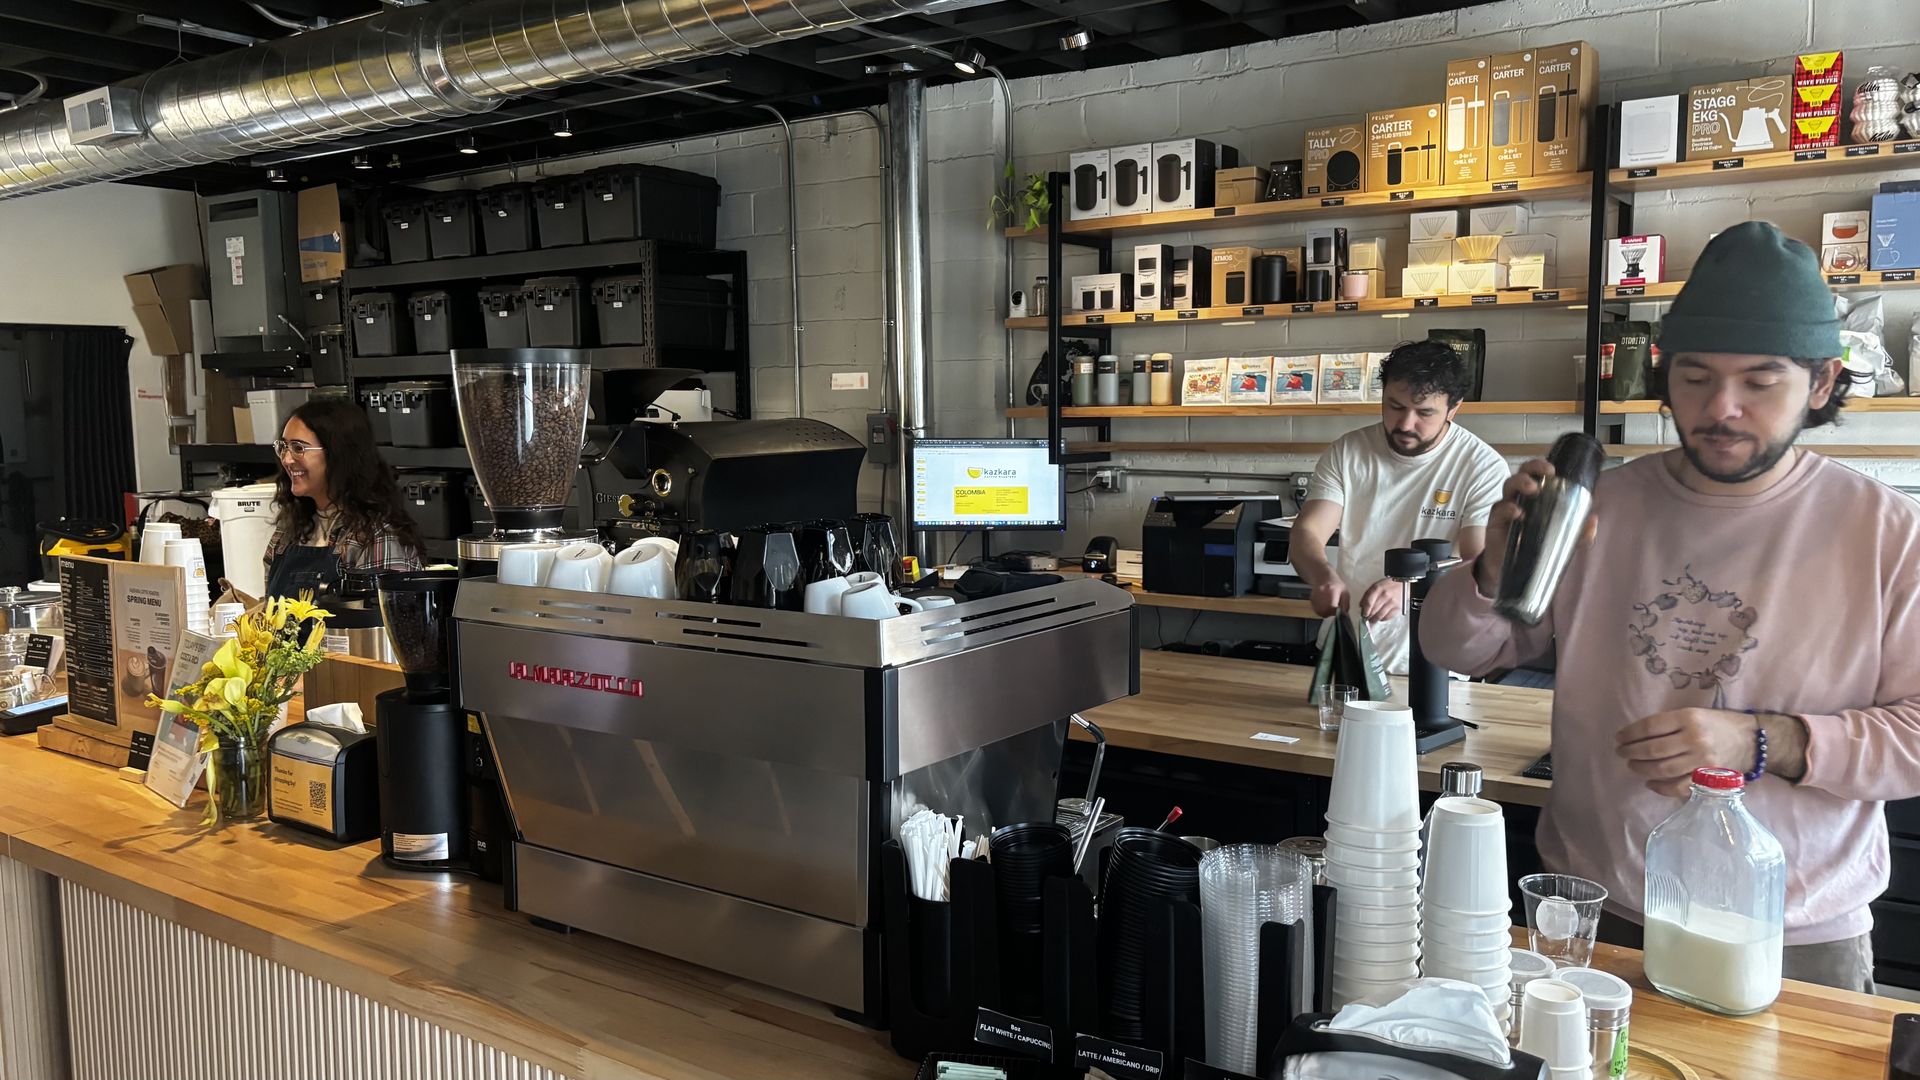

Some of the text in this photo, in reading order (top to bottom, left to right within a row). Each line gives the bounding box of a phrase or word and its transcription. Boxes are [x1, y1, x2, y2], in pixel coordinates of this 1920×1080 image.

[1539, 62, 1571, 74] CARTER
[1448, 75, 1478, 86] CARTER
[1493, 69, 1524, 80] CARTER
[1693, 95, 1736, 110] STAGG
[1693, 110, 1717, 123] EKG
[1372, 120, 1412, 134] CARTER
[1692, 122, 1720, 136] PRO
[1308, 138, 1336, 149] TALLY
[1422, 506, 1455, 516] kazkara
[60, 560, 74, 569] menu
[127, 595, 161, 607] SPRING MENU
[1010, 1024, 1021, 1032] 8oz
[980, 1023, 994, 1033] FLAT
[995, 1027, 1013, 1039] WHITE
[1018, 1035, 1052, 1050] CAPUCCINO
[1111, 1048, 1126, 1057] 12oz
[1078, 1050, 1098, 1060] LATTE
[1102, 1056, 1141, 1070] AMERICANO
[1145, 1065, 1160, 1074] DRIP
